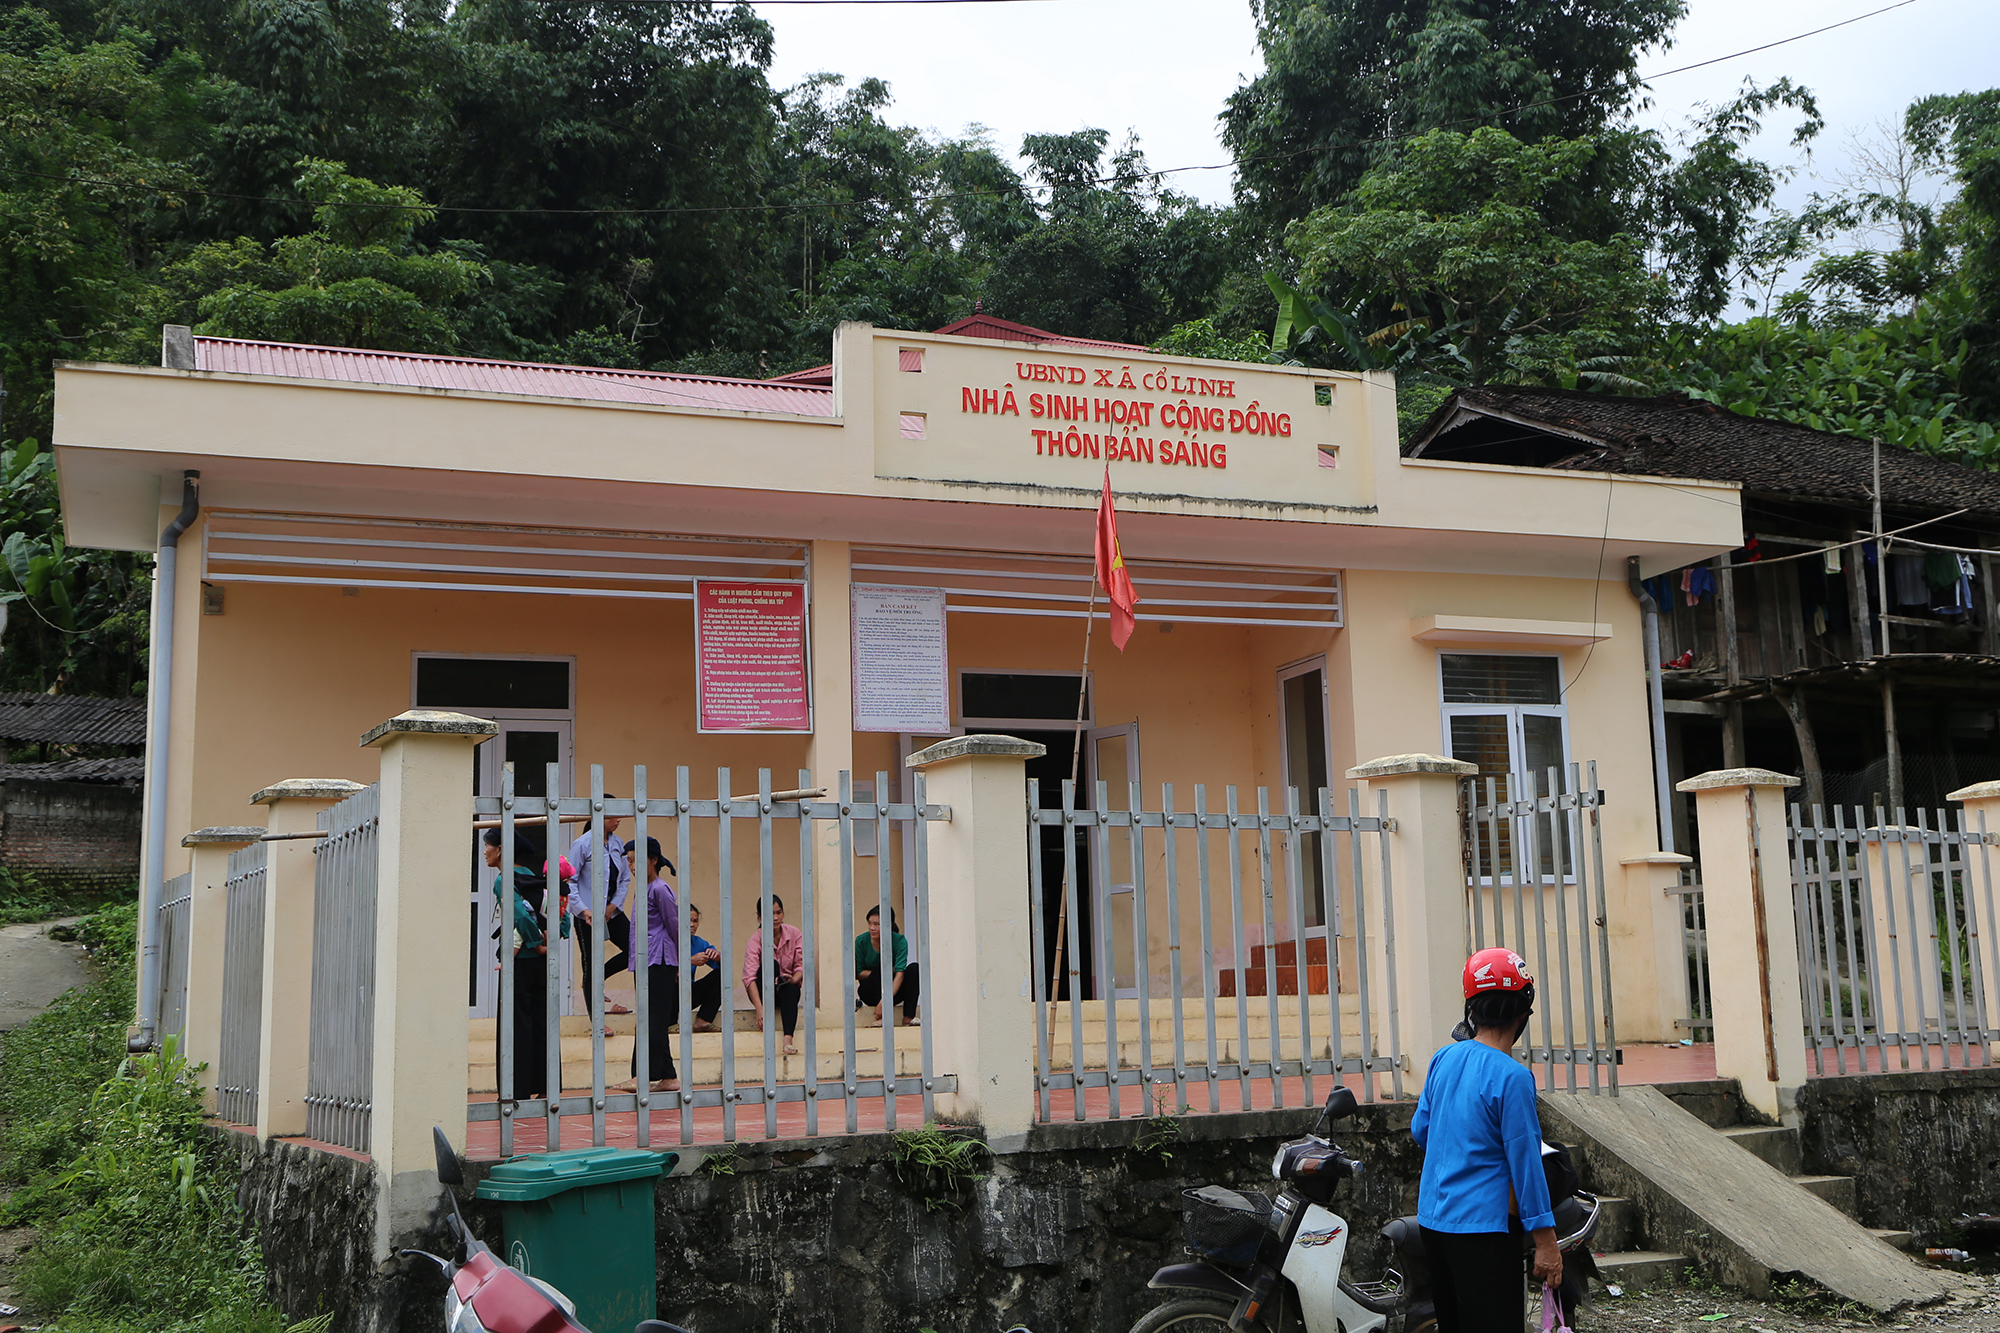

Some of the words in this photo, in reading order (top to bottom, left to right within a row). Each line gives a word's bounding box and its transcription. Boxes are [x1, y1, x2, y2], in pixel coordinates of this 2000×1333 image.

[1016, 362, 1087, 385] UBND
[1142, 366, 1168, 391] CỔ
[1171, 375, 1236, 398] LINH
[1029, 393, 1089, 421] SINH
[1094, 398, 1155, 431] HOẠT
[1160, 399, 1225, 436] CỘNG
[1228, 400, 1292, 437] ĐỒNG
[1031, 425, 1100, 459] THÔN
[1104, 425, 1154, 463] BẢN
[1159, 433, 1227, 468] SÁNG
